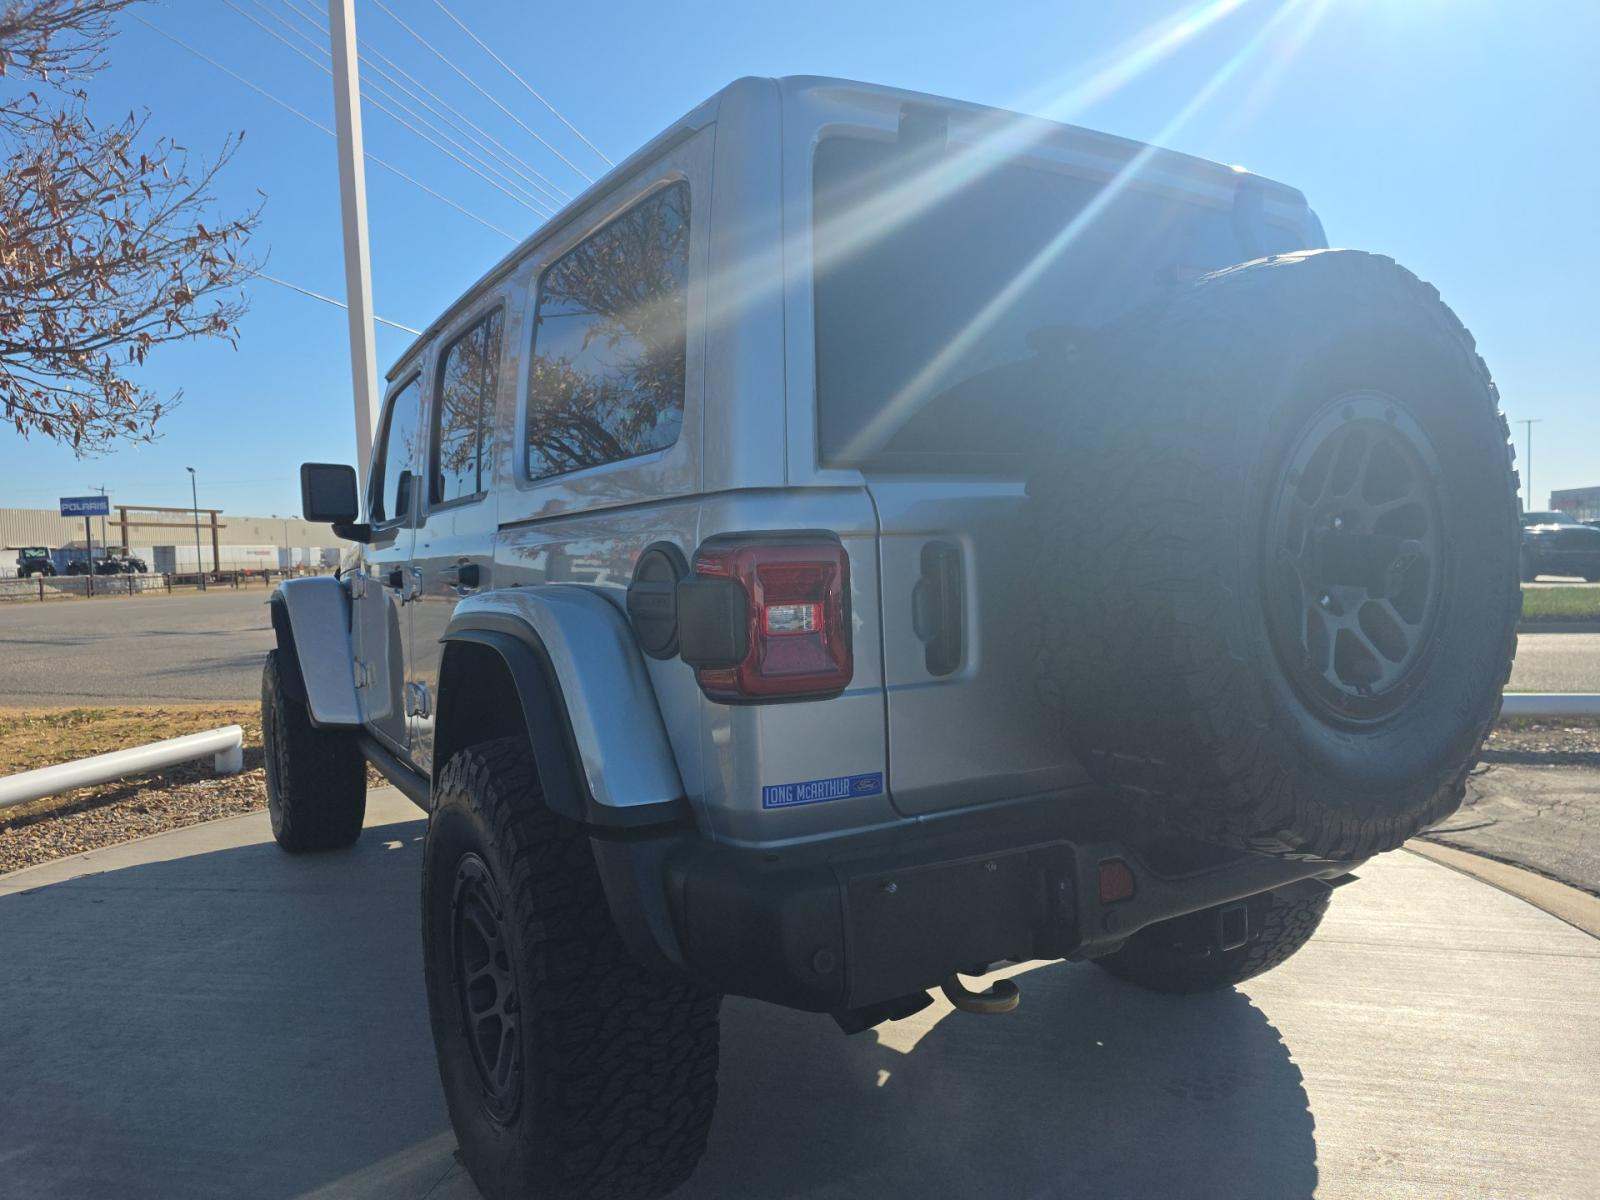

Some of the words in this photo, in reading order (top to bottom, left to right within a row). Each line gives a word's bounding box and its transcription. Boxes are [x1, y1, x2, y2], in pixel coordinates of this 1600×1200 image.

[63, 502, 107, 511] POLARIS
[766, 786, 793, 806] LONG
[796, 778, 850, 801] McARTHUR
